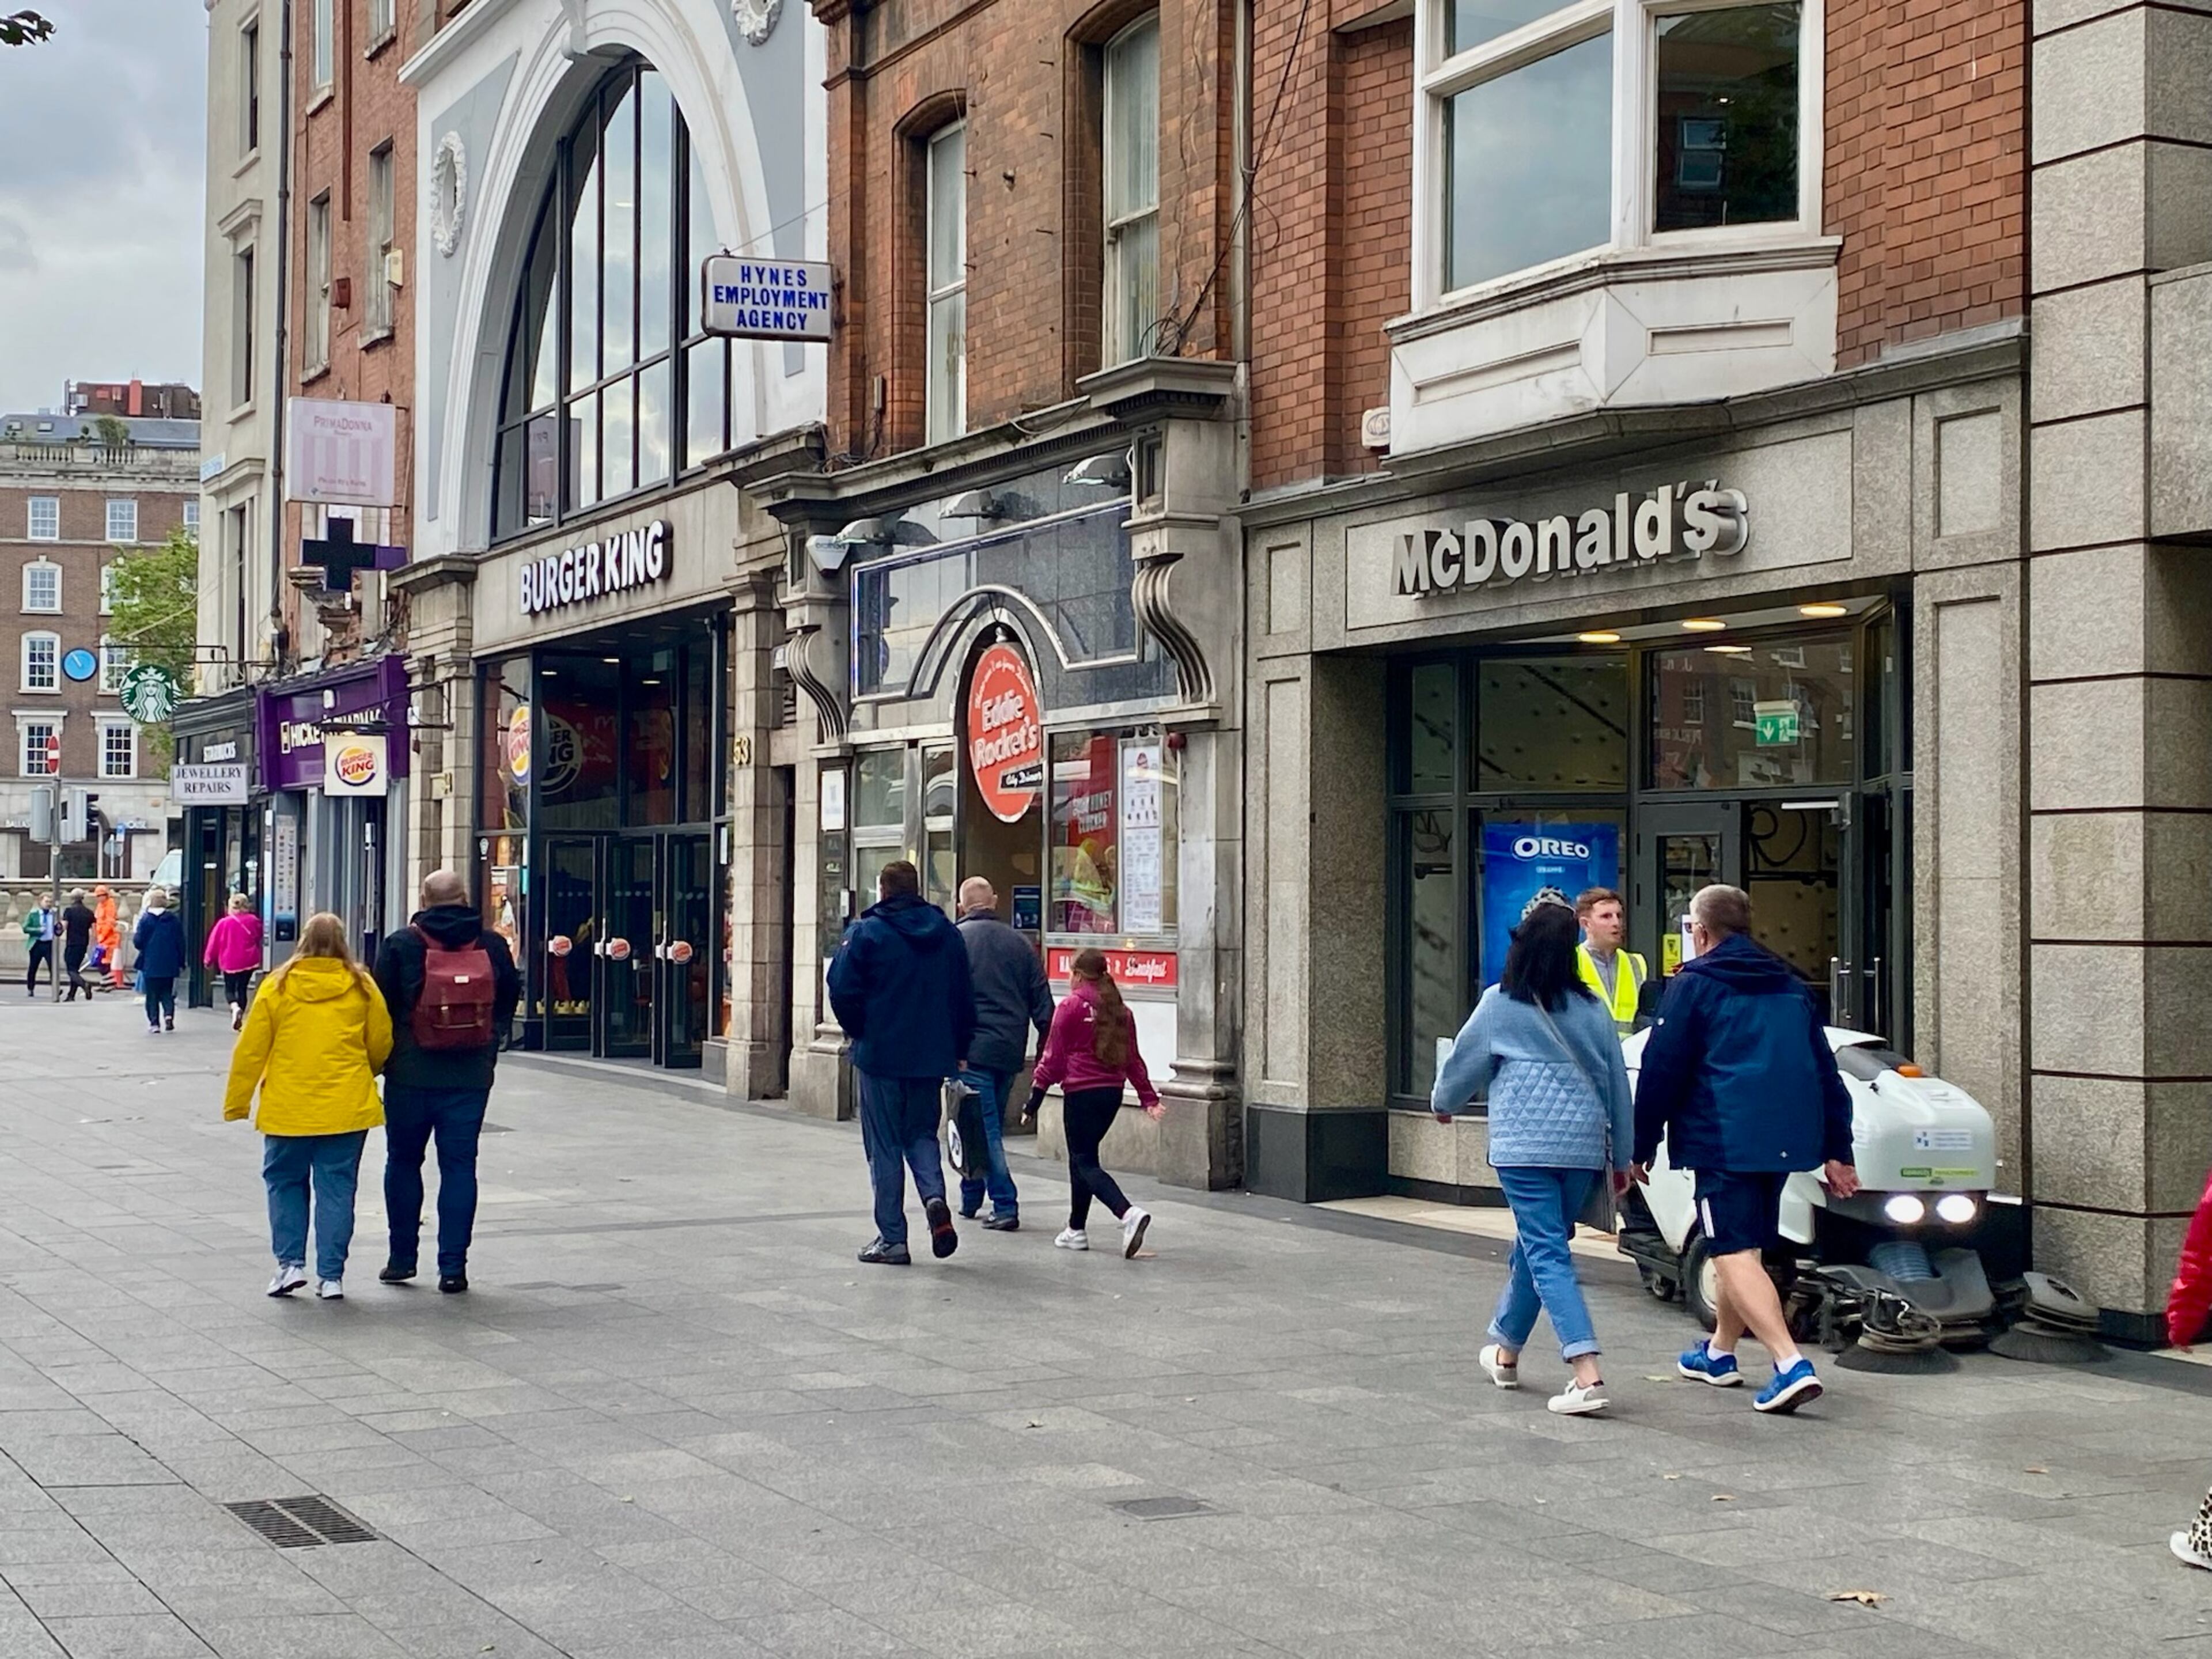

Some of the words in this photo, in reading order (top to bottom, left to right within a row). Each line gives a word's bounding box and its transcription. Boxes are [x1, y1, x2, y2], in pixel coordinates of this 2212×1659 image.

[741, 266, 806, 286] HYNES
[714, 286, 828, 309] EMPLOYMENT
[737, 309, 808, 330] AGENCY
[1391, 479, 1748, 594] McDonald's
[520, 542, 601, 615] BURGER
[605, 520, 668, 592] KING
[982, 690, 1024, 732] Eddie
[975, 716, 1038, 770] Rocket's
[341, 752, 373, 767] BURGER
[342, 760, 374, 777] KING
[176, 766, 243, 779] JEWELLERY
[184, 782, 232, 794] REPAIRS
[5, 819, 31, 828] BALLAS
[1514, 838, 1590, 858] OREO
[1124, 955, 1168, 984] Breakfast
